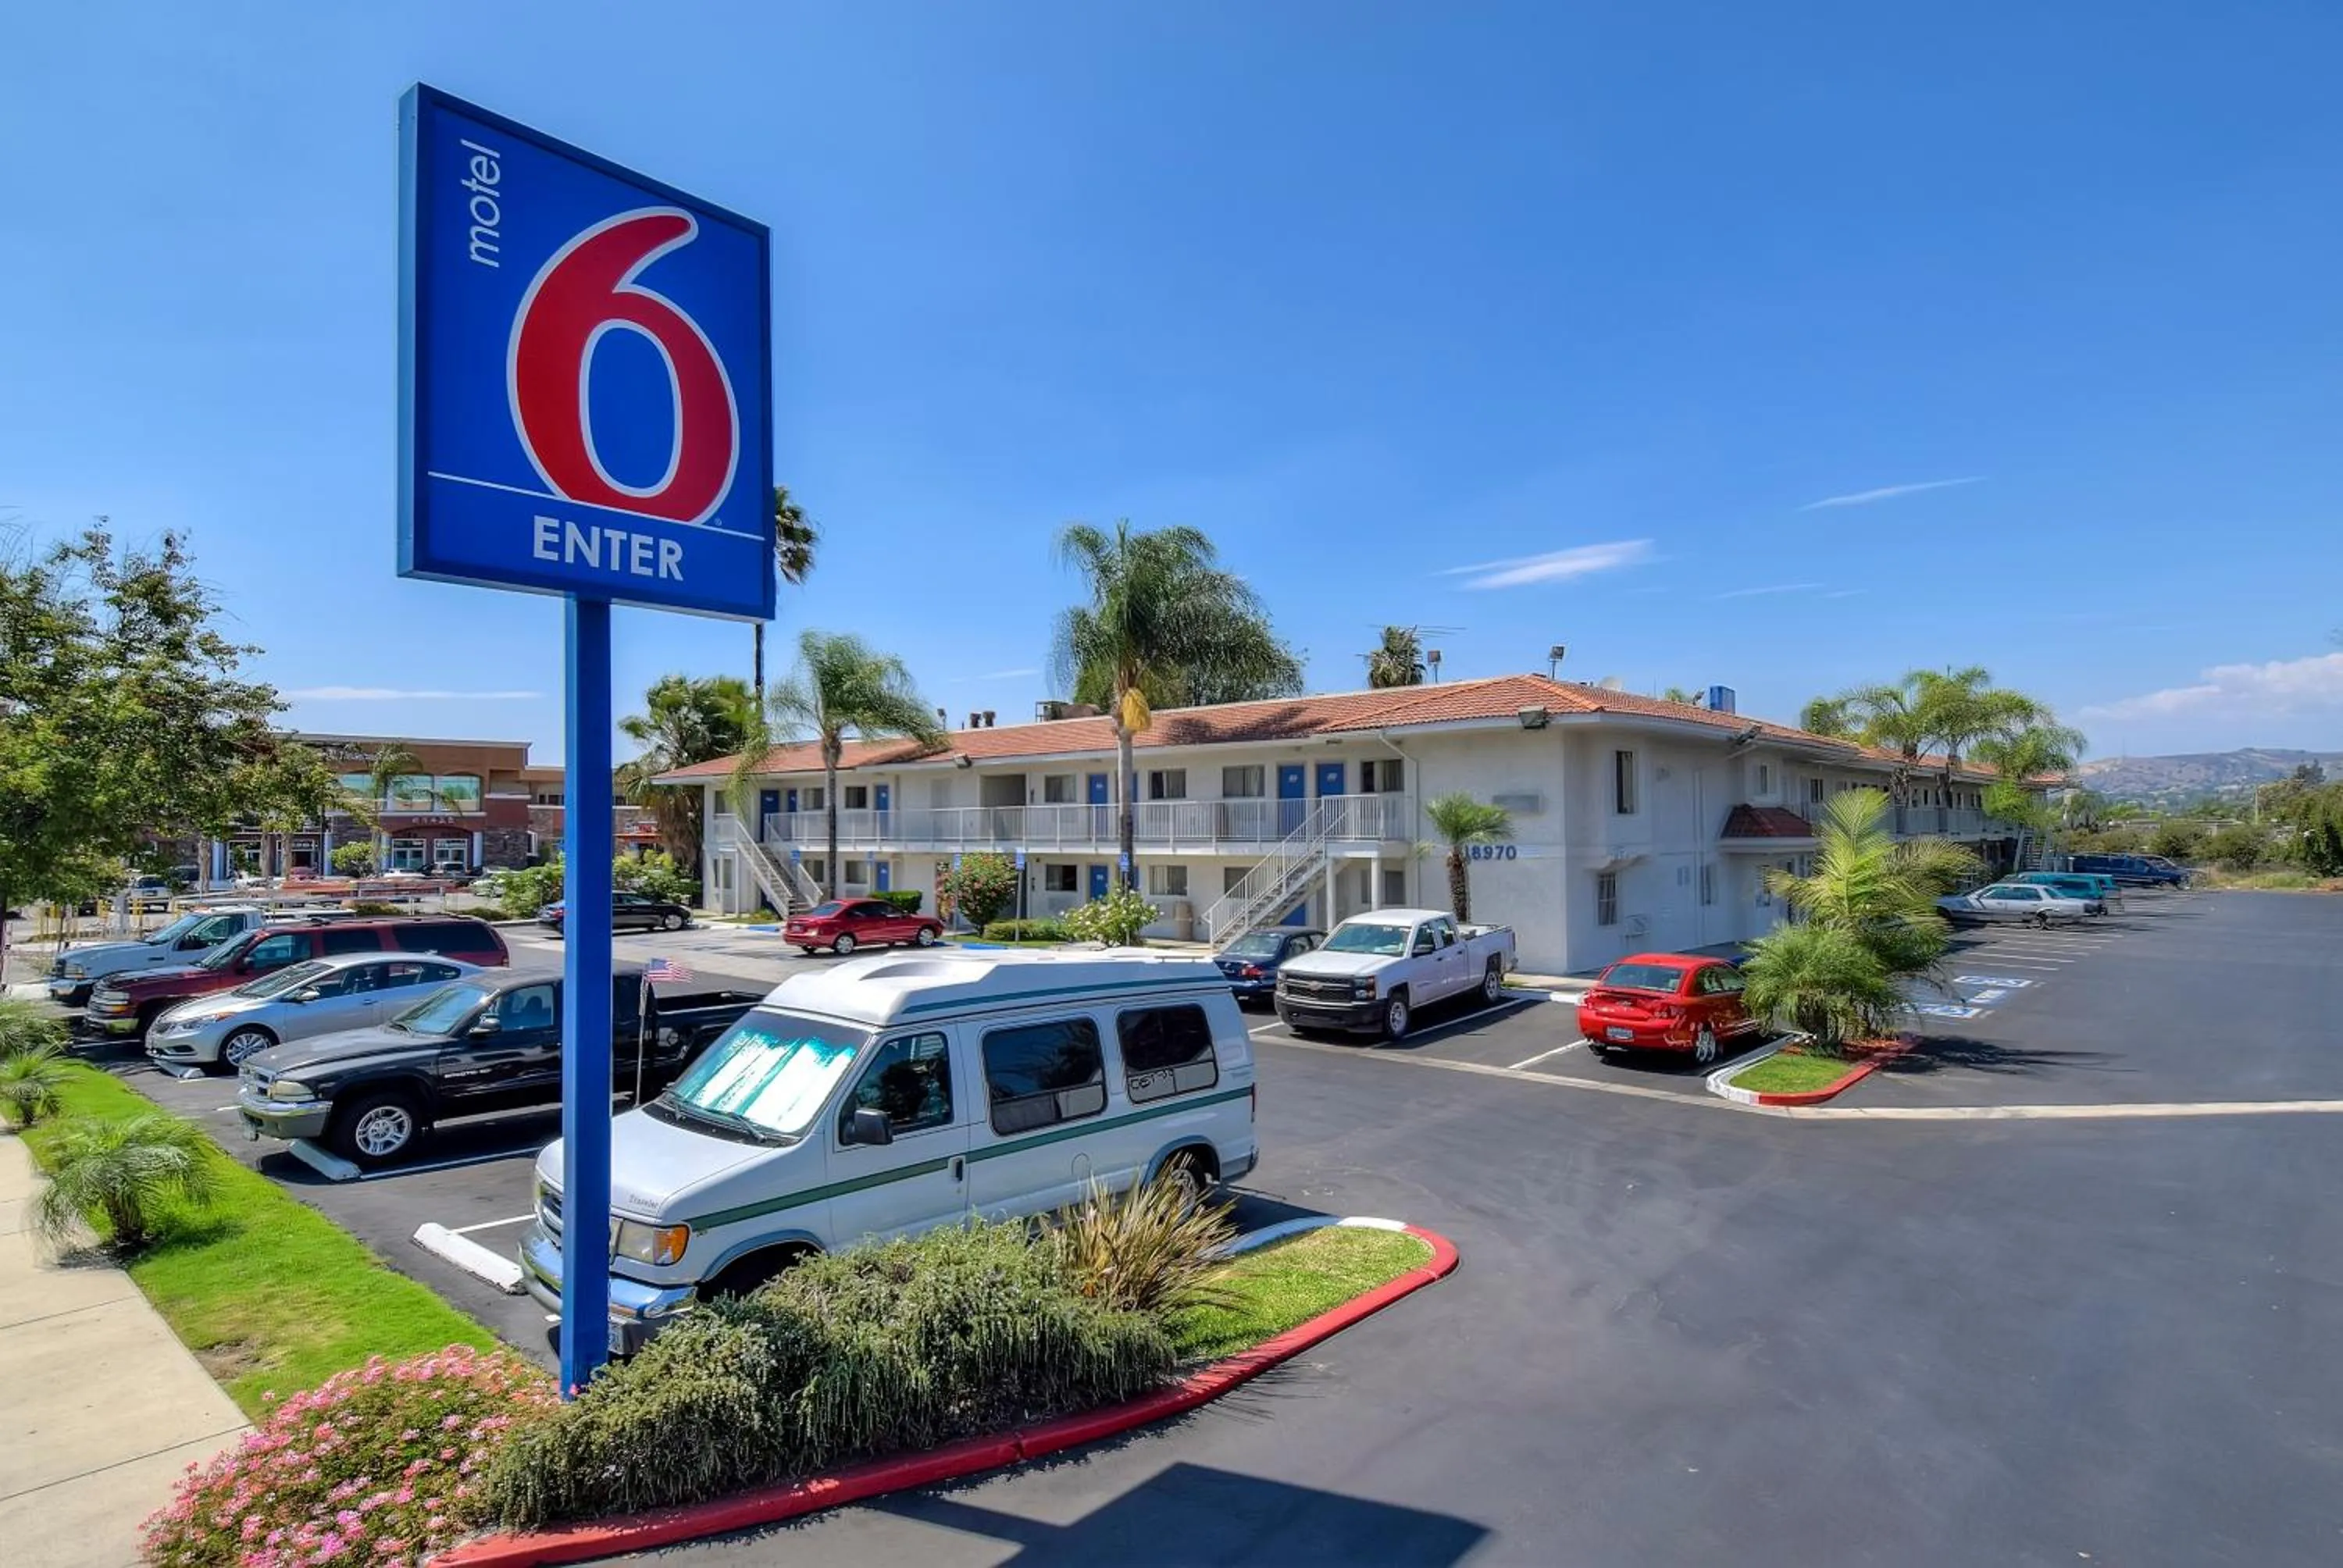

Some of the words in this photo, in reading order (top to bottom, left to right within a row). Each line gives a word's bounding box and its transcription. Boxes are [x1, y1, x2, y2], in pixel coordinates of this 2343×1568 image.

[460, 138, 501, 268] motel
[506, 205, 740, 526] 6
[533, 515, 684, 581] ENTER
